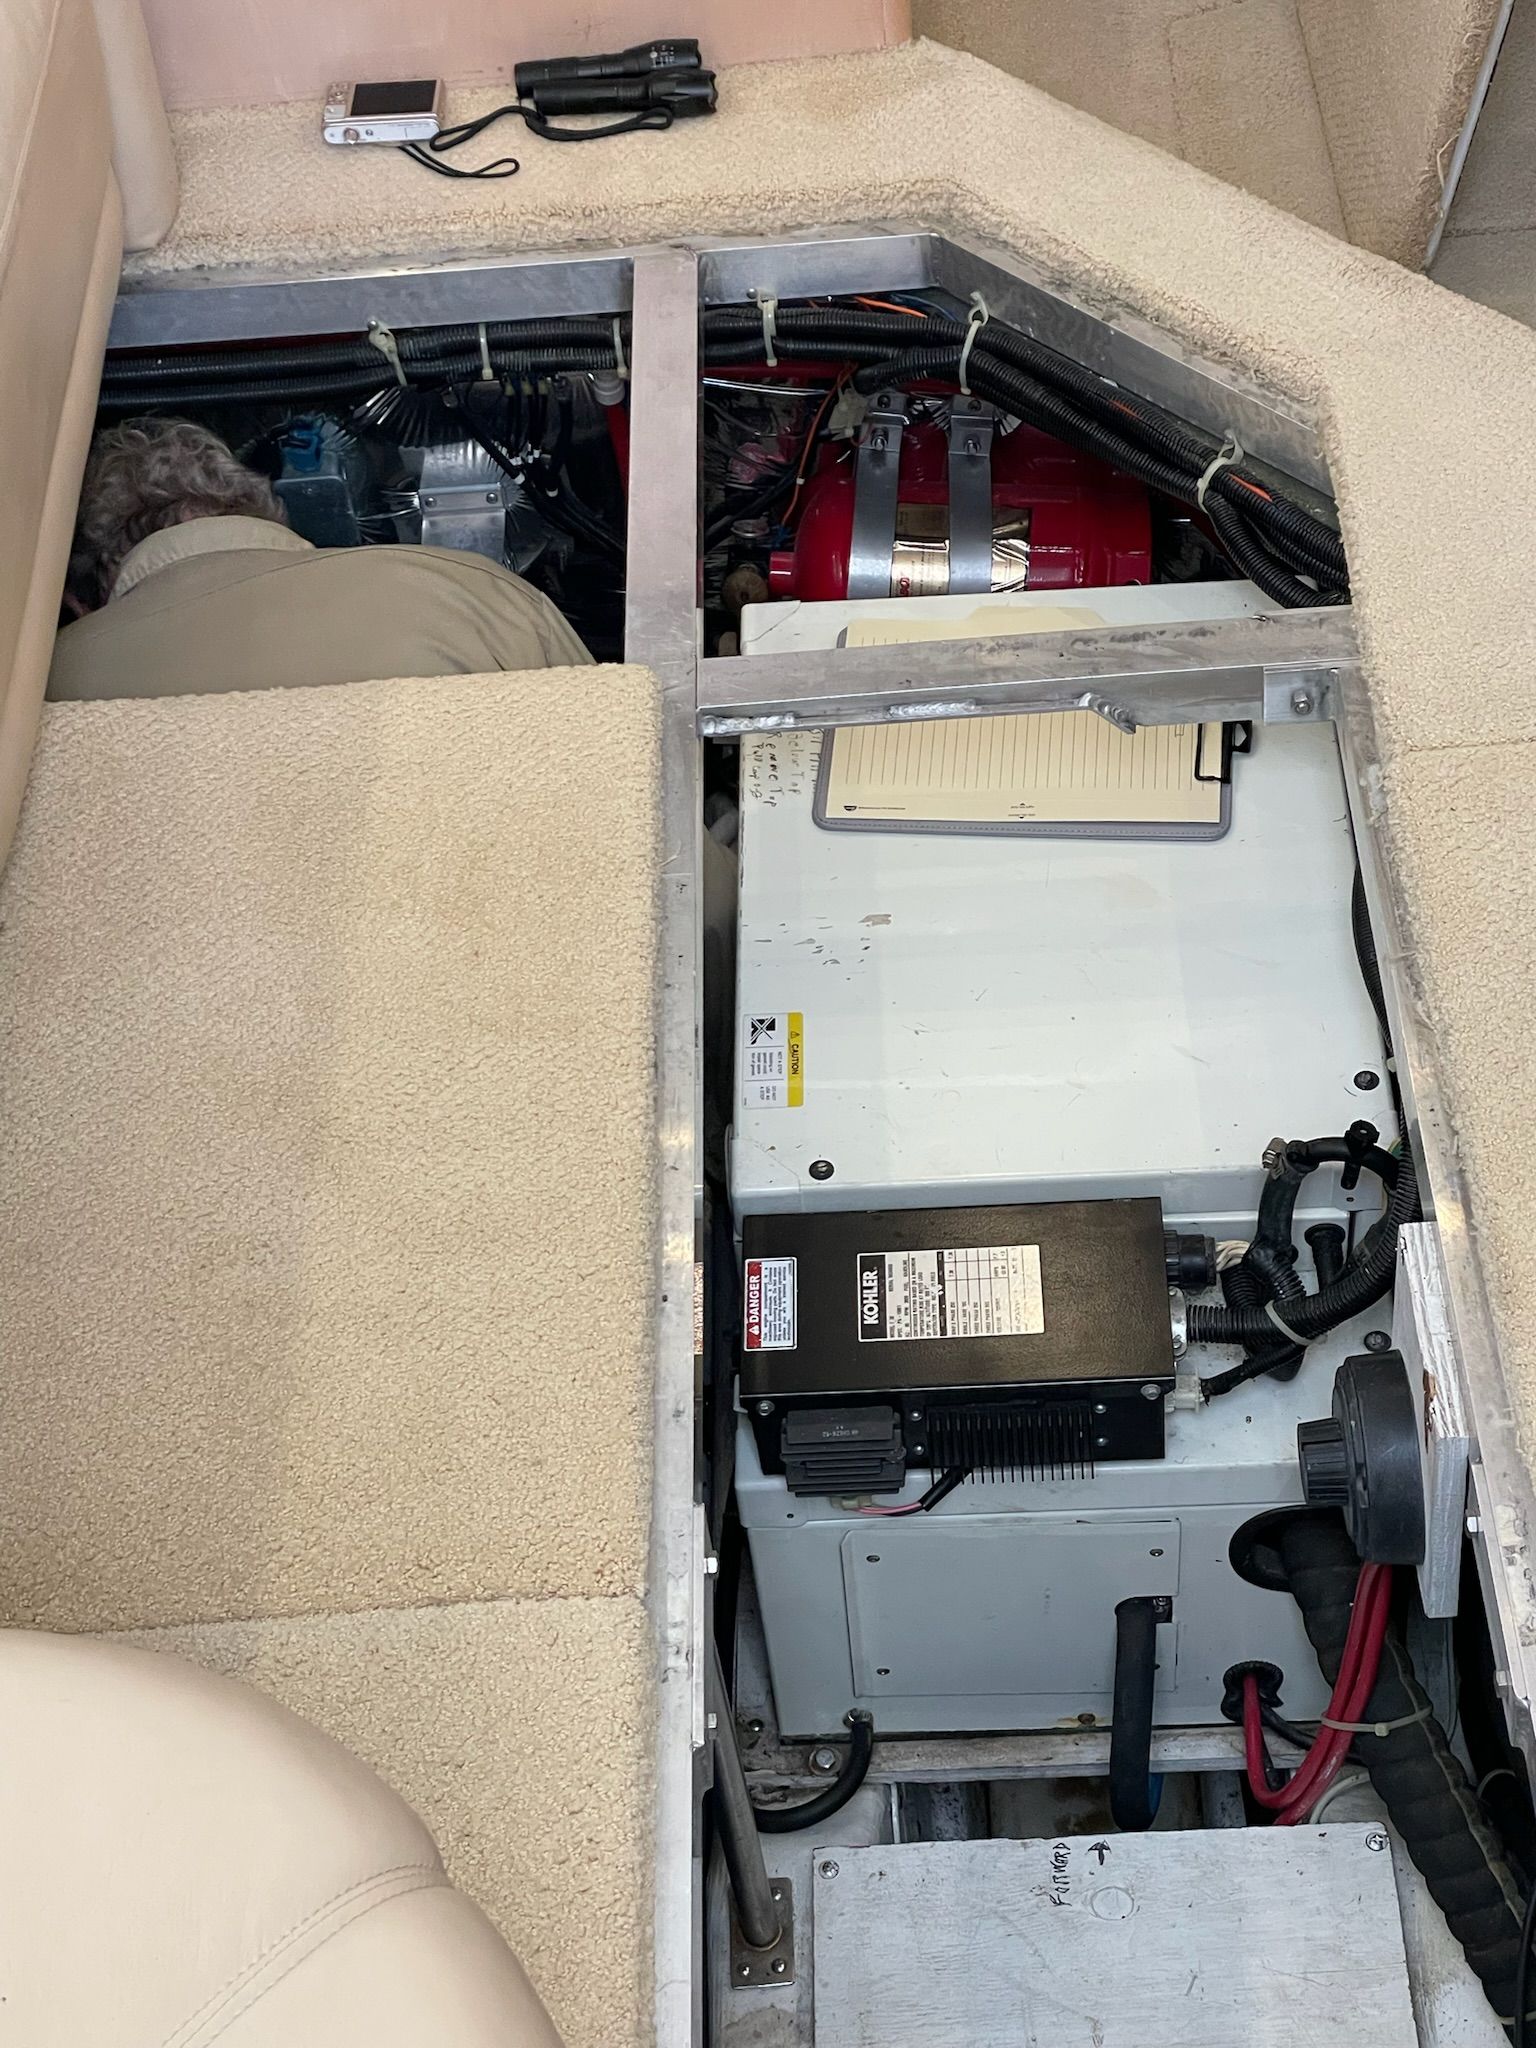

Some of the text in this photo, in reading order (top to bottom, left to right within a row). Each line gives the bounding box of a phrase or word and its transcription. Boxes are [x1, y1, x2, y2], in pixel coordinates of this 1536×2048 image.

[791, 1044, 799, 1075] CAUTION
[749, 1275, 760, 1323] DANGER
[862, 1270, 879, 1325] KOHLER
